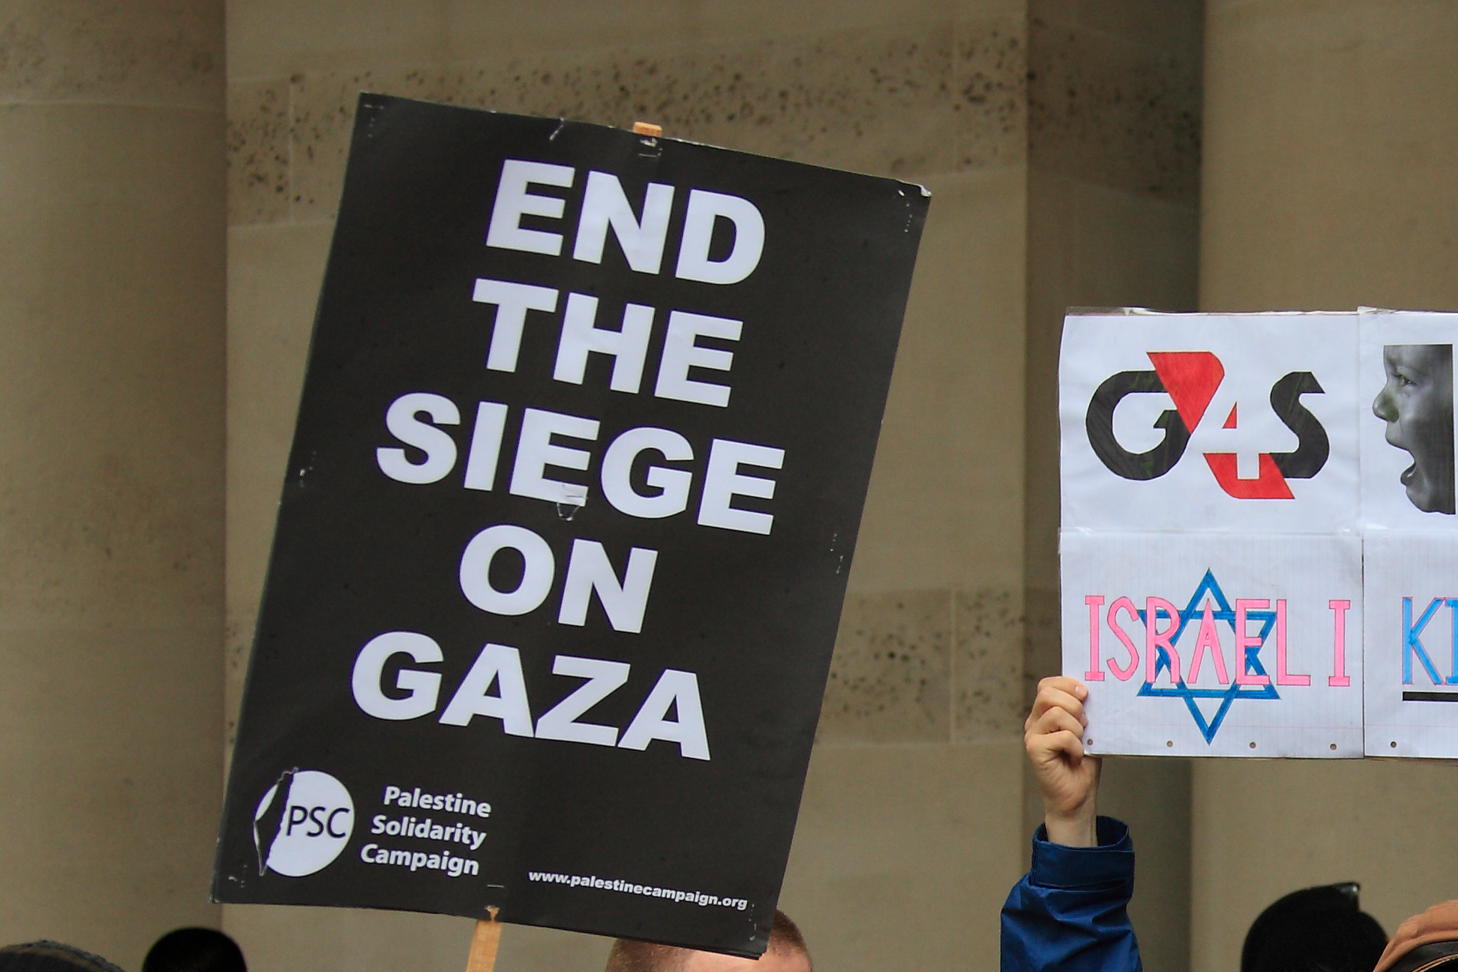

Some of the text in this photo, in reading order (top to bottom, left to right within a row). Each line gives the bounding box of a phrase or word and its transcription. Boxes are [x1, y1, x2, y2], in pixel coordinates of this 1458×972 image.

[486, 159, 766, 285] END
[472, 278, 744, 408] THE
[376, 392, 786, 536] SIEGE
[1085, 351, 1330, 500] G4S
[459, 524, 659, 634] ON
[351, 631, 711, 761] GAZA
[286, 805, 350, 839] PSC
[371, 815, 487, 850] Solidarity
[383, 786, 492, 818] Palestine
[360, 844, 479, 877] Campaign
[528, 871, 748, 911] www.palestinecampaign.org
